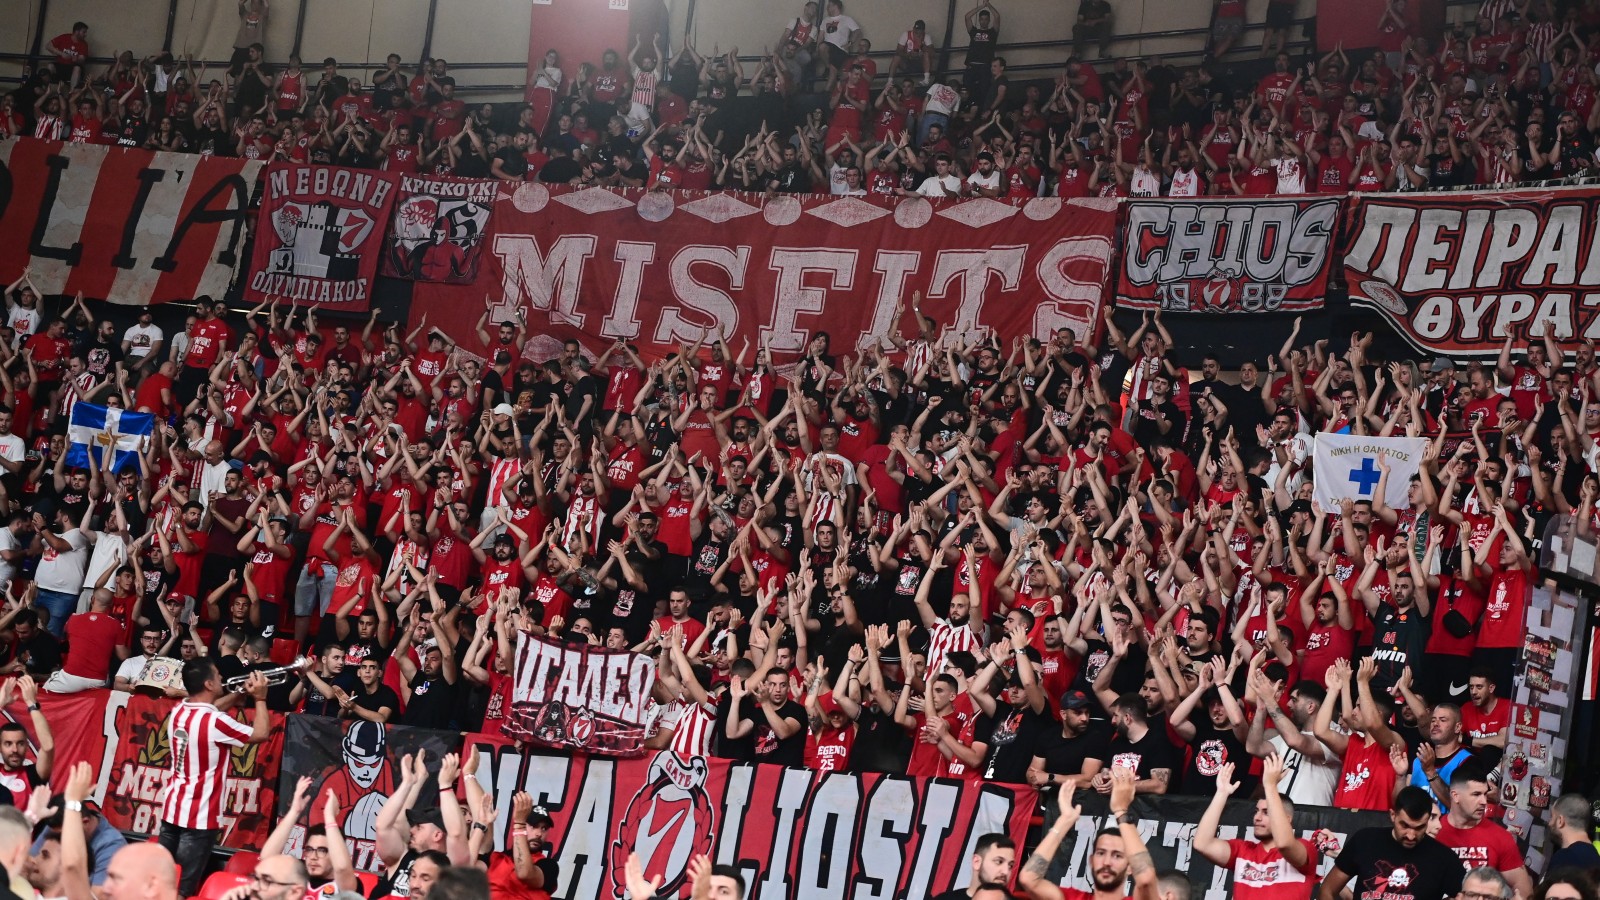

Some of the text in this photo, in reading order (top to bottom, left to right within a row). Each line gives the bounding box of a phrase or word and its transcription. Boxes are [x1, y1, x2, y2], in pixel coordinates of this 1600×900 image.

[270, 168, 392, 209] ΜΕΘΩΝΗ
[401, 176, 499, 197] ΚΡΙΕΚΟΥΚΙ
[0, 156, 249, 272] LIA
[1125, 202, 1340, 287] CHIOS
[251, 271, 367, 302] ΟΛΥΜΠΙΑΚΟΣ
[490, 234, 1113, 352] MISFITS
[1412, 294, 1574, 340] ΘΥΡΑ
[1330, 446, 1351, 457] ΝΙΚΗ
[1372, 645, 1407, 662] bwin
[817, 745, 846, 758] EGEND
[820, 759, 834, 770] 25
[664, 758, 693, 787] GATE
